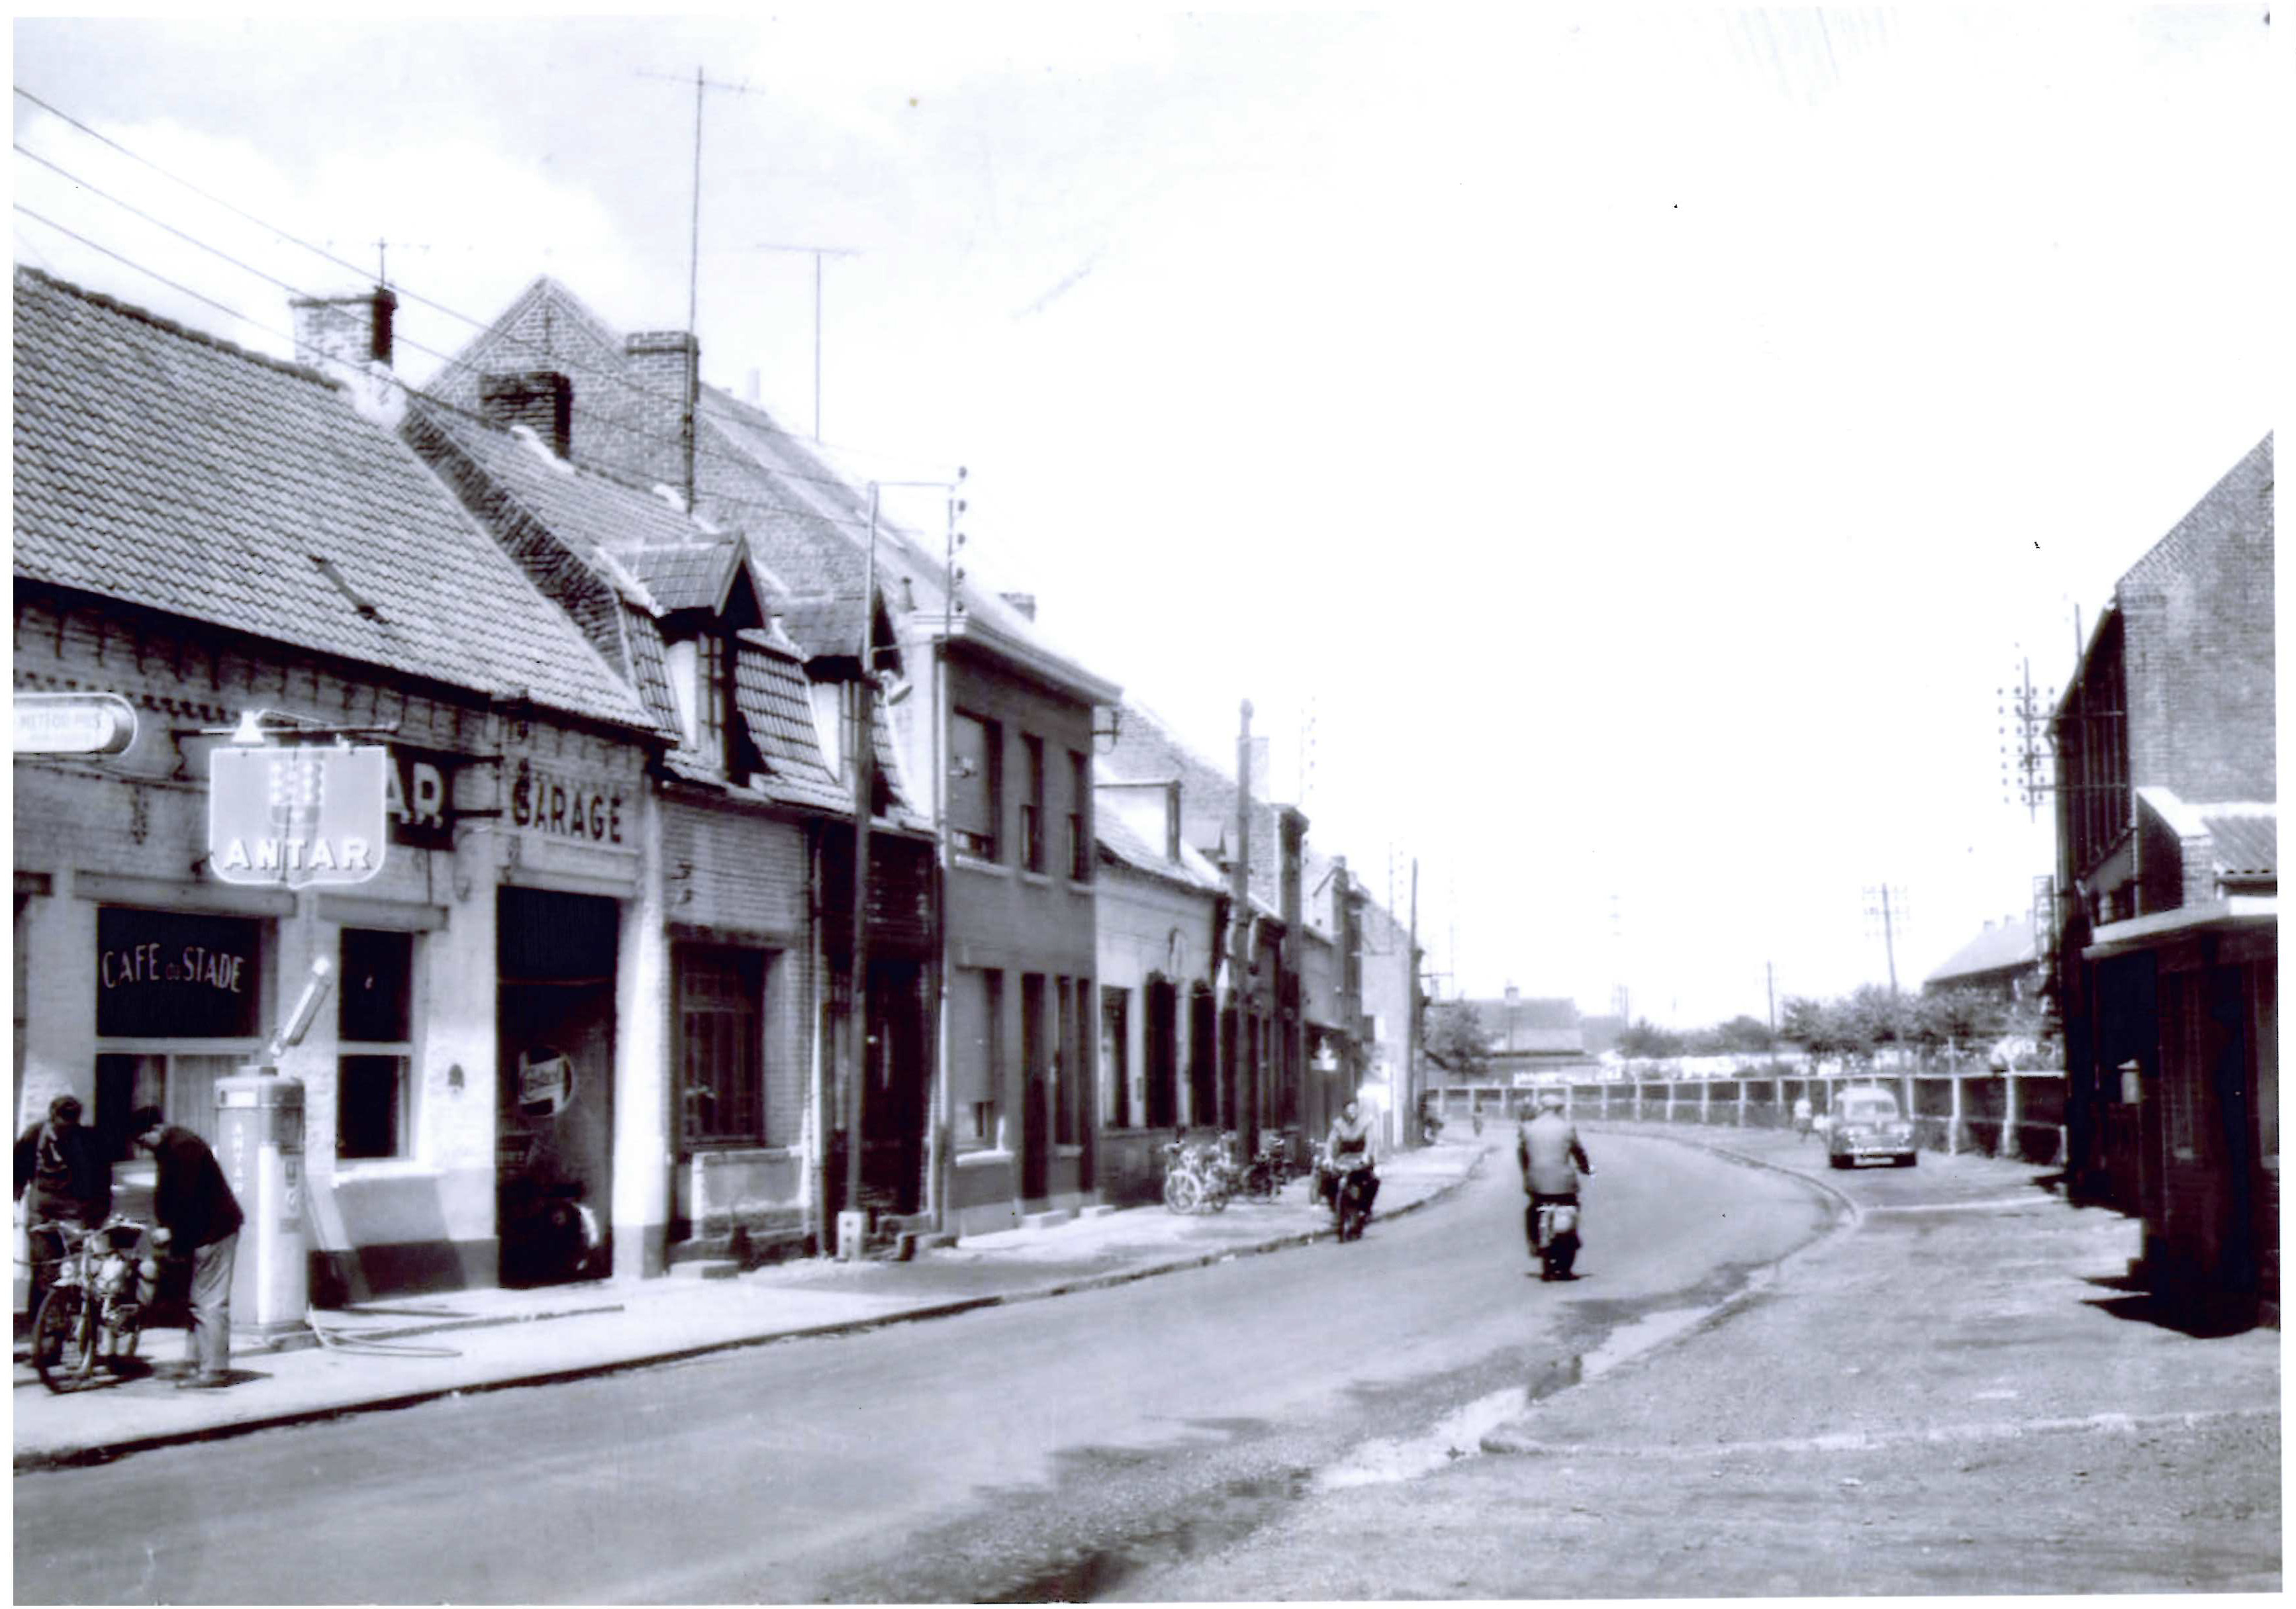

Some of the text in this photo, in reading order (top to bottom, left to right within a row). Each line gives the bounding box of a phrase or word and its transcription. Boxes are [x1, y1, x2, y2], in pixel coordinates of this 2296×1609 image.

[513, 777, 621, 843] GARAGE
[224, 837, 372, 869] ANTAR
[103, 943, 160, 988] CAFE
[183, 946, 245, 993] STADE
